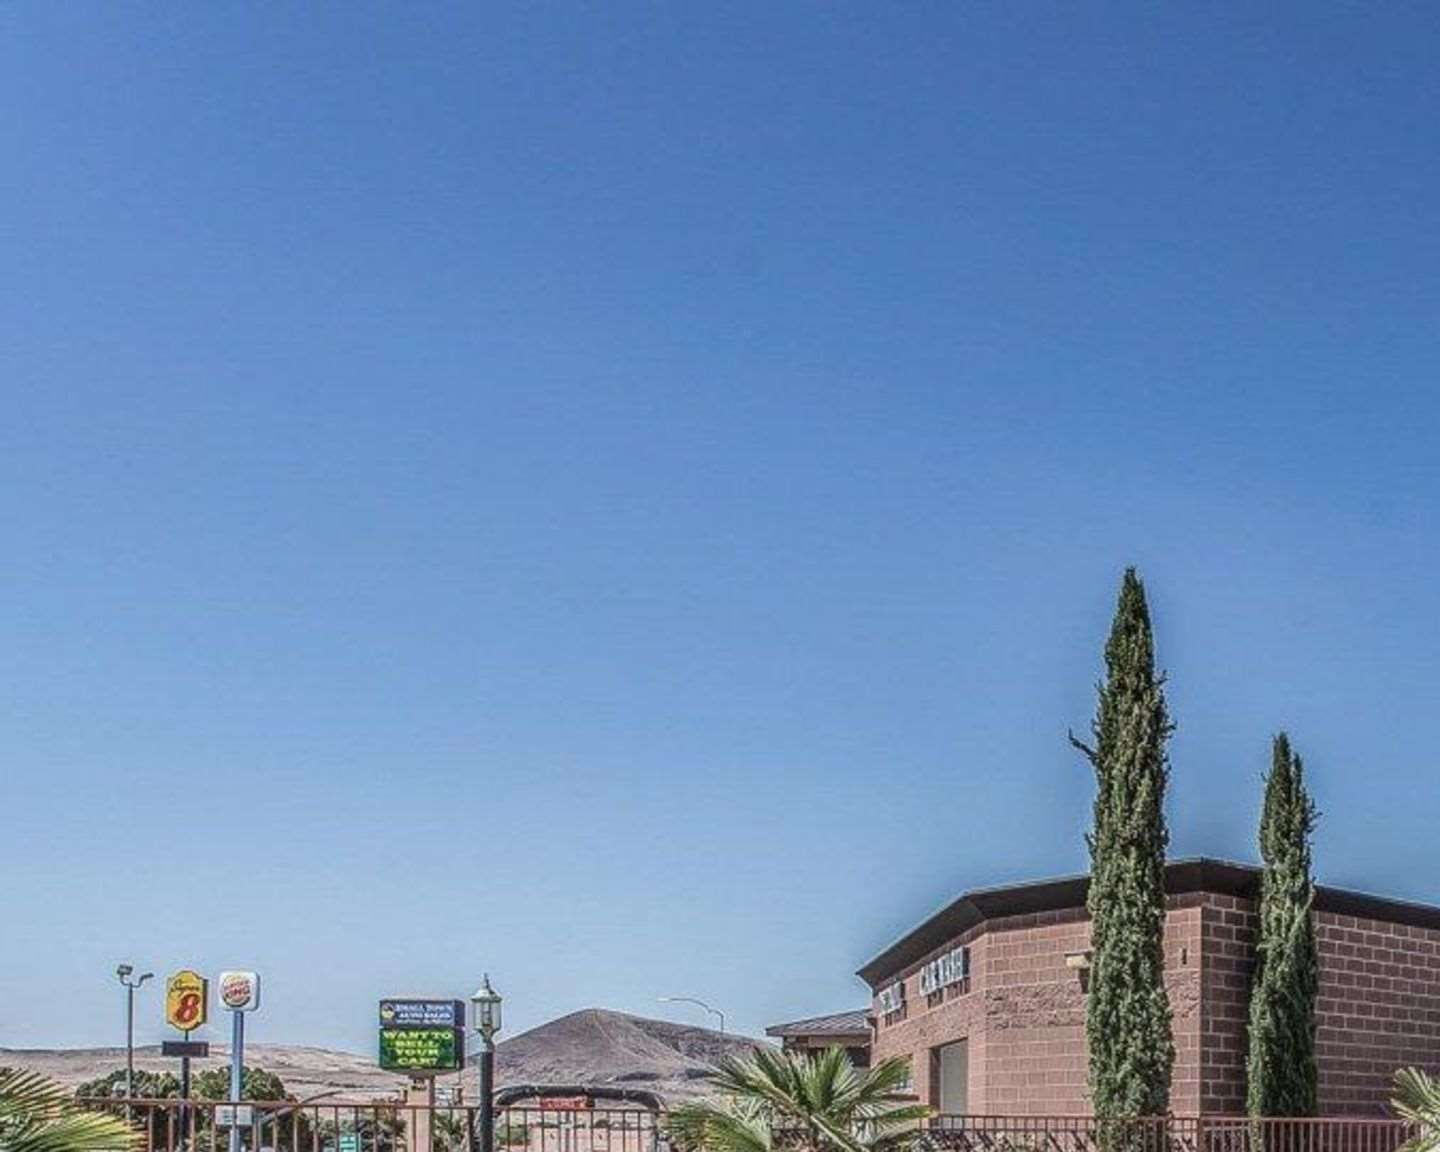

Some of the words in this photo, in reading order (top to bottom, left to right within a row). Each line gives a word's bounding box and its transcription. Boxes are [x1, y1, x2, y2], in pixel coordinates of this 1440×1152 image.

[224, 985, 251, 999] KING
[174, 993, 200, 1023] 8
[383, 1031, 429, 1040] WANT
[431, 1031, 453, 1040] TO
[395, 1040, 440, 1048] SELL
[395, 1049, 440, 1057] YOUR
